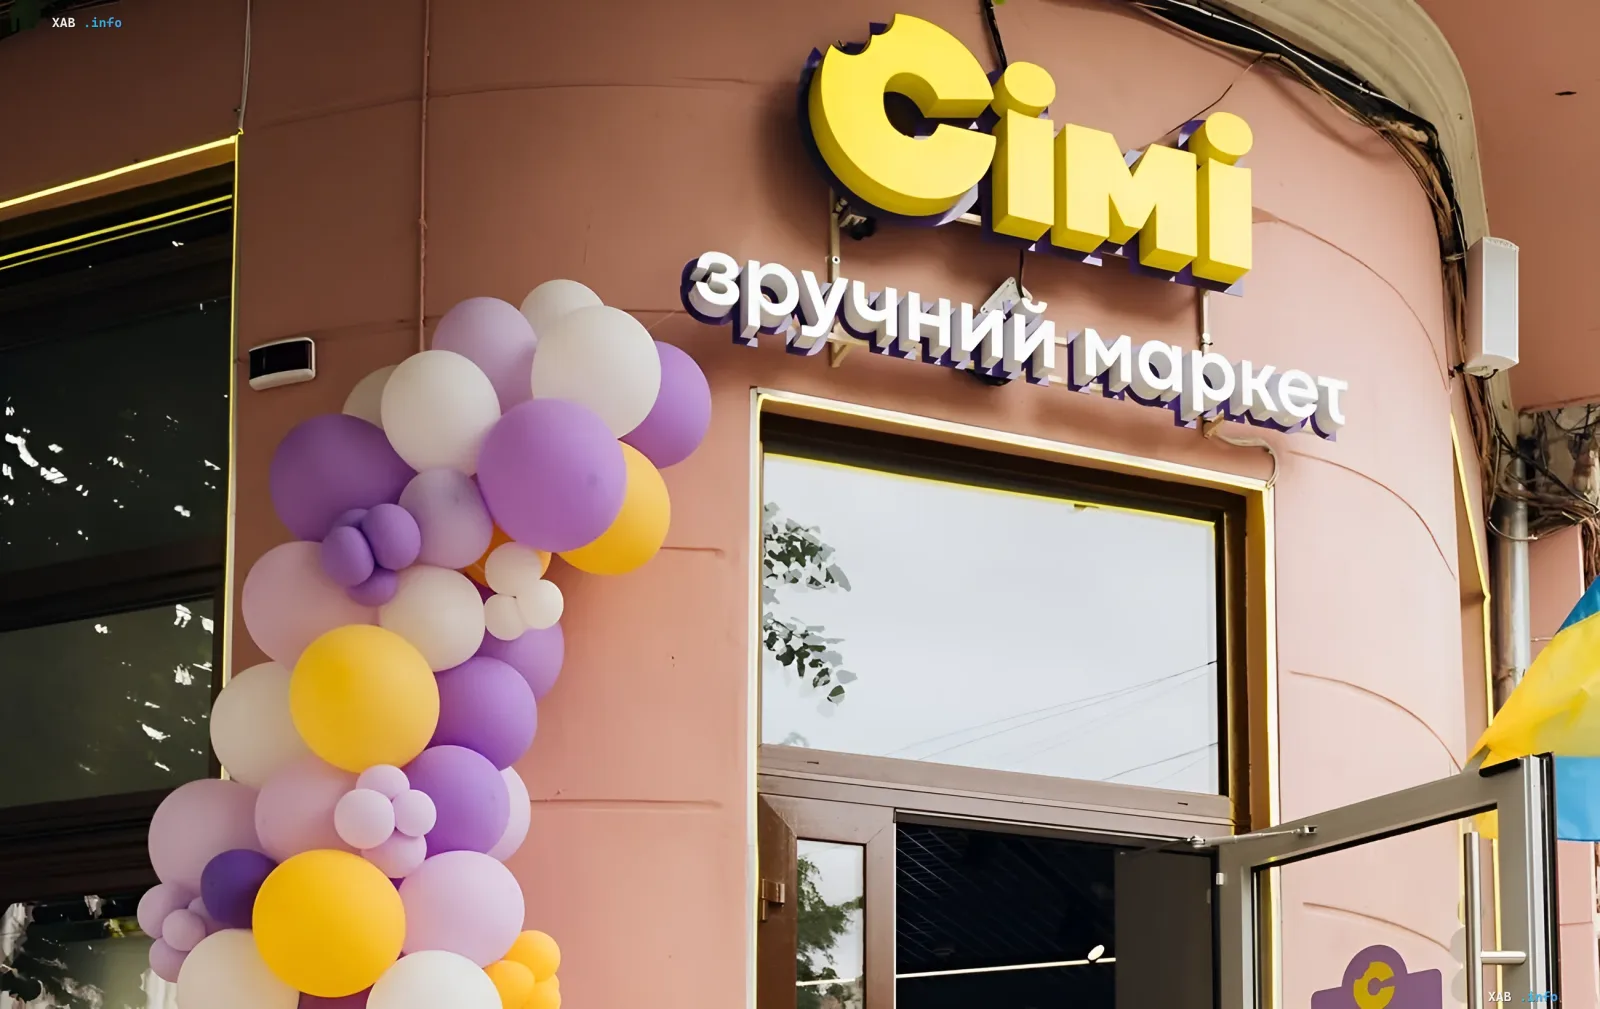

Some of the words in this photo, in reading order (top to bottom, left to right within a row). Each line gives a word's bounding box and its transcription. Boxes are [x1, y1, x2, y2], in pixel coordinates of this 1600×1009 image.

[809, 13, 1253, 284] Сімі
[690, 251, 1056, 376] зручний
[1076, 327, 1349, 428] маркет
